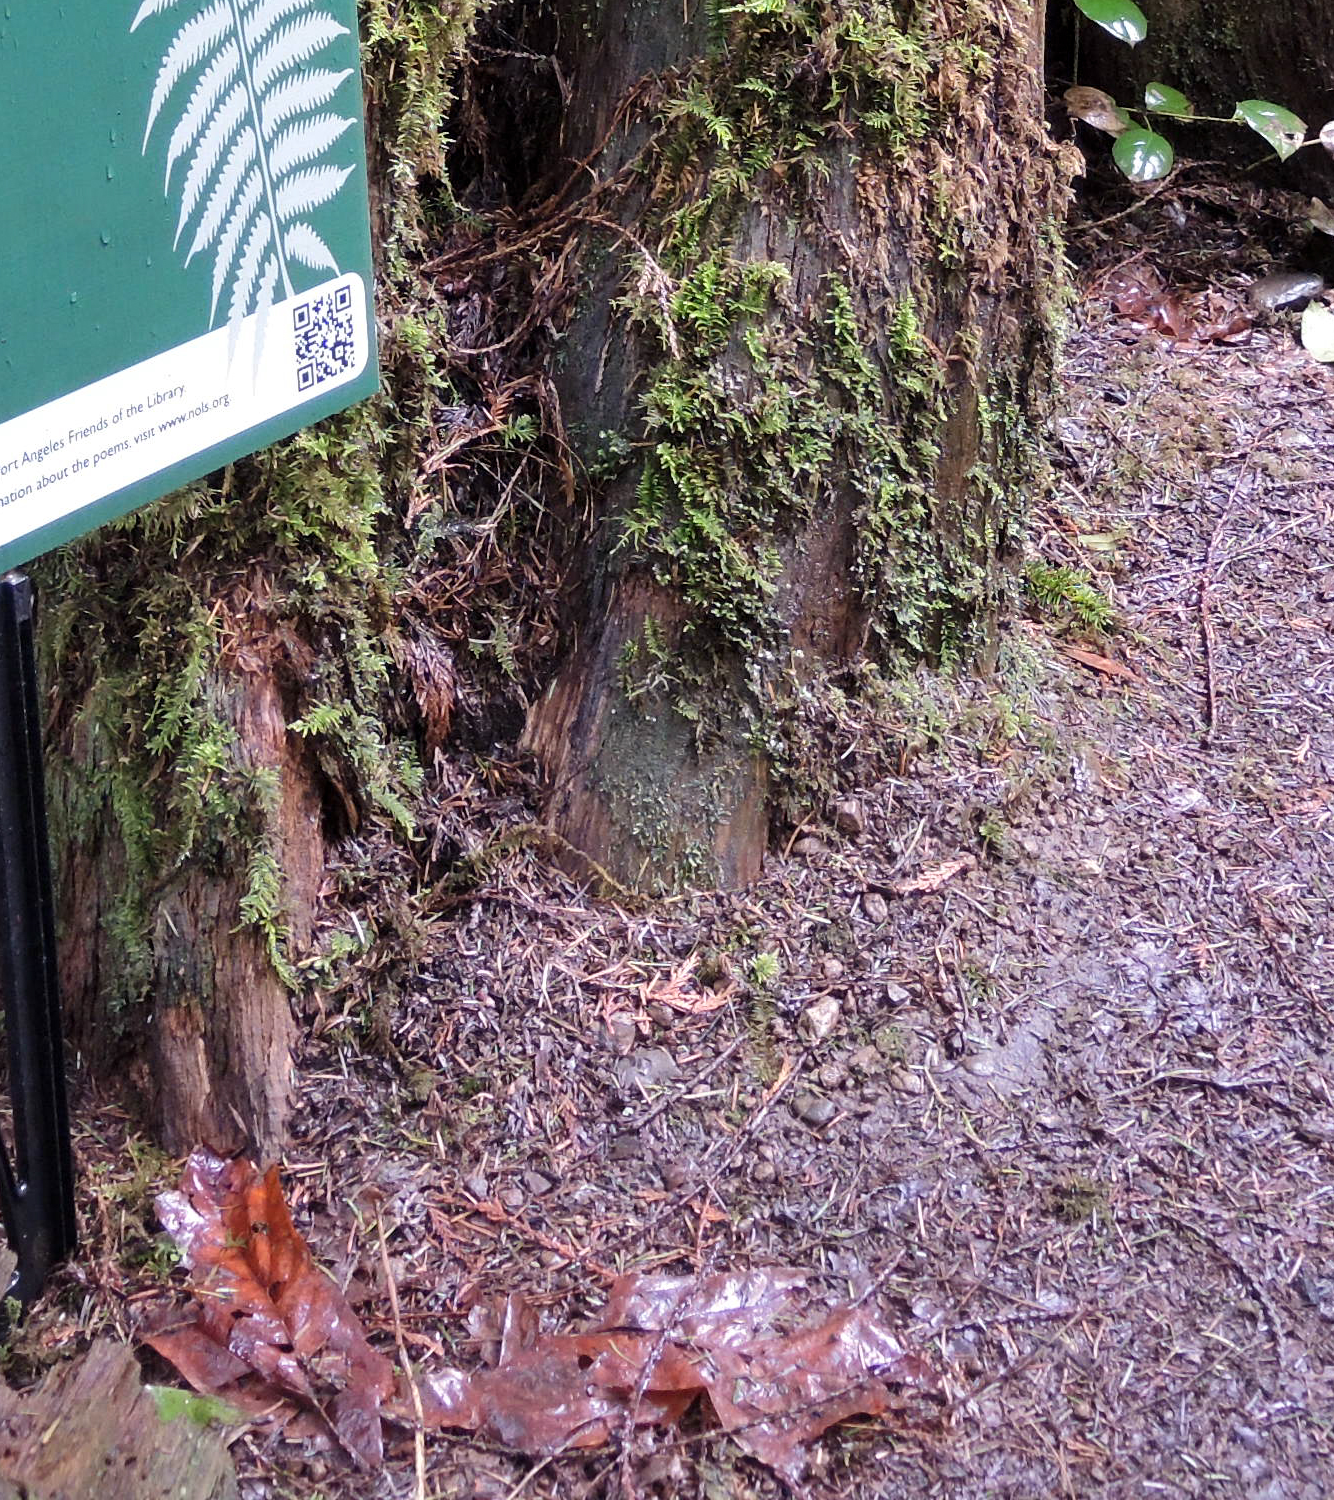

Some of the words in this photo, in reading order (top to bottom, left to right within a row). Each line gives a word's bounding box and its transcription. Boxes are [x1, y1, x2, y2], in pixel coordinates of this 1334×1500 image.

[20, 438, 65, 465] Angeles
[67, 416, 109, 444] Friends
[111, 408, 123, 424] of
[125, 403, 144, 417] the
[35, 467, 69, 490] about
[70, 458, 90, 473] the
[132, 427, 156, 443] visit
